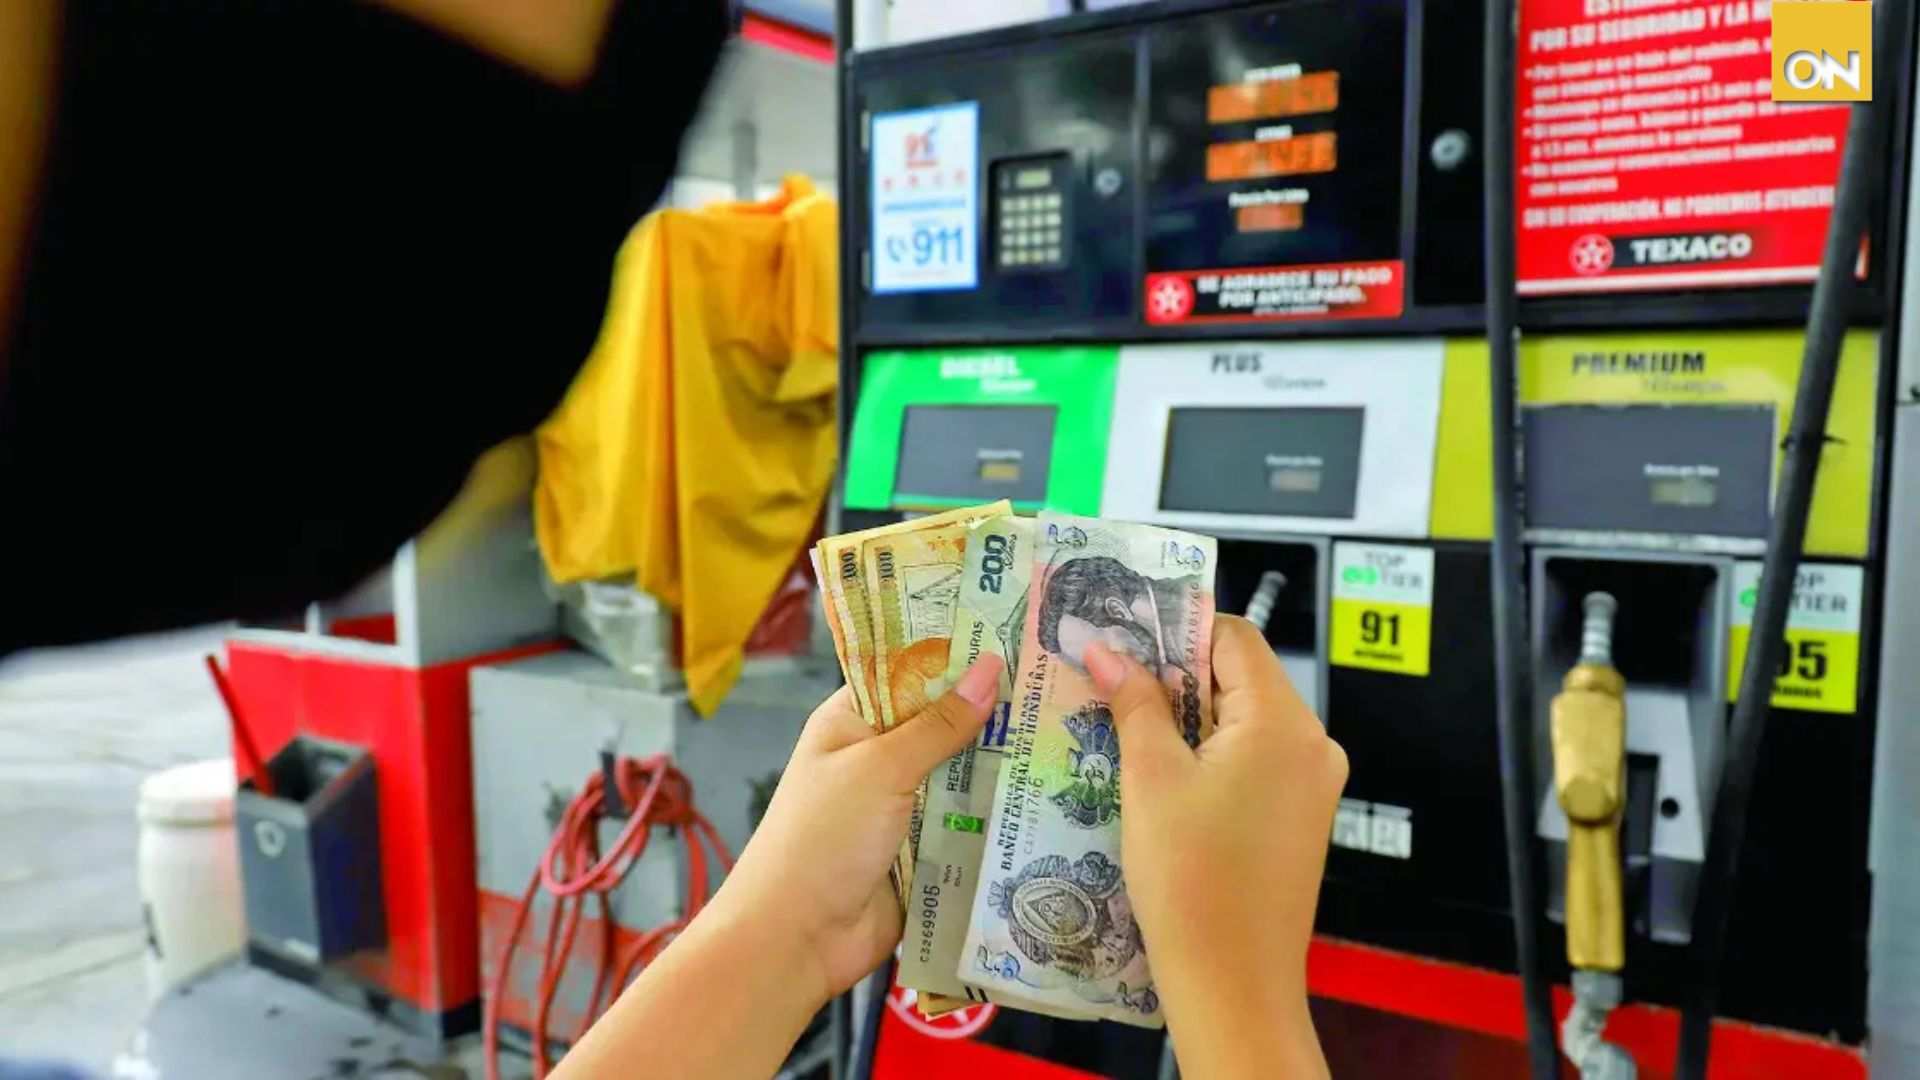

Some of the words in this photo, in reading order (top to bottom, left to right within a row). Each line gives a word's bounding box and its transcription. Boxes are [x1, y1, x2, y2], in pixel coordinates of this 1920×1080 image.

[912, 225, 964, 266] 911
[1629, 232, 1752, 264] TEXACO
[1221, 271, 1311, 291] AGRADECE
[1342, 267, 1392, 285] PAGO
[1211, 352, 1264, 374] PLUS
[1572, 351, 1707, 375] PREMIUM
[841, 550, 858, 580] 100
[880, 550, 895, 580] 100
[979, 534, 1008, 595] 200
[1359, 609, 1402, 647] 91
[1026, 652, 1049, 735] HONDURAS
[1020, 737, 1035, 758] DE
[1013, 759, 1031, 819] CENTRAL
[1001, 821, 1020, 872] BANCO
